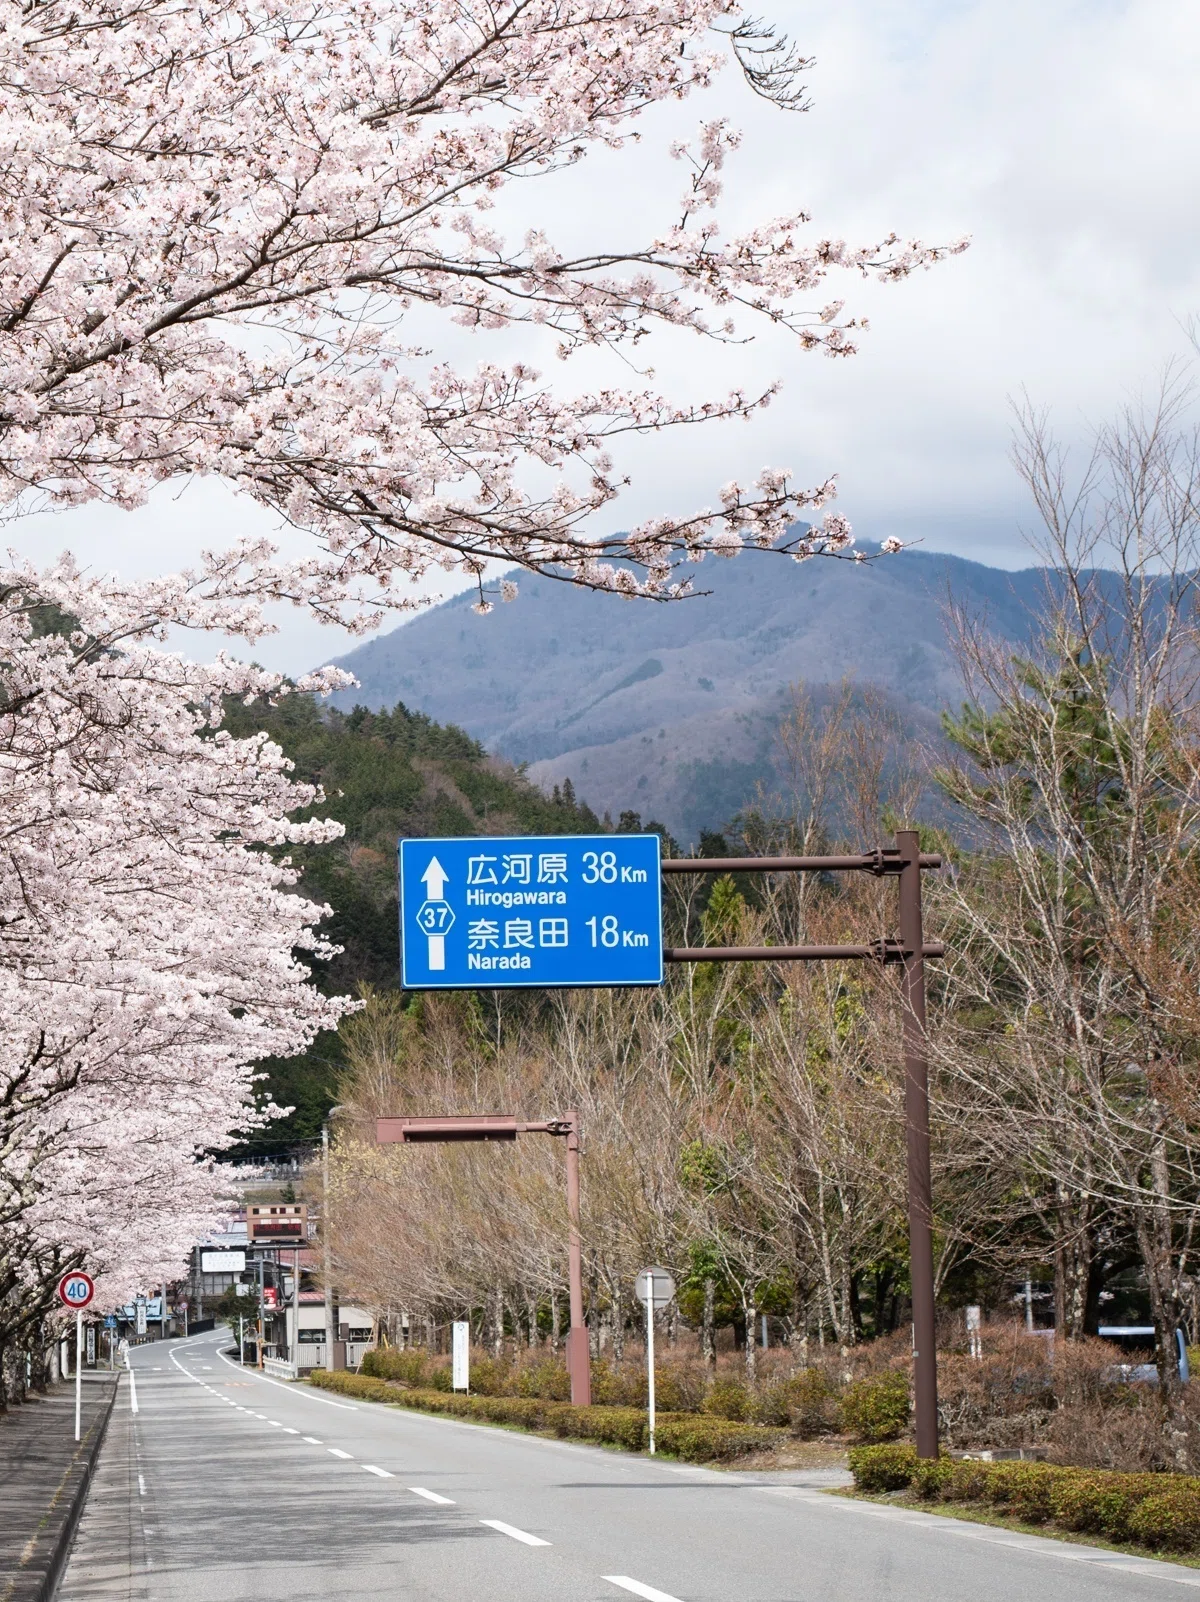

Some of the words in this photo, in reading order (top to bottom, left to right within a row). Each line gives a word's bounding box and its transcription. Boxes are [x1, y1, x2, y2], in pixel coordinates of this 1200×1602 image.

[467, 854, 568, 884] 広河原
[583, 852, 617, 883] 38
[622, 867, 646, 882] Km
[467, 889, 566, 908] Hirogawara
[424, 908, 448, 928] 37
[468, 918, 568, 949] 奈良田
[586, 916, 619, 947] 18
[623, 931, 648, 946] Km
[469, 953, 530, 969] Narada
[68, 1283, 86, 1298] 40
